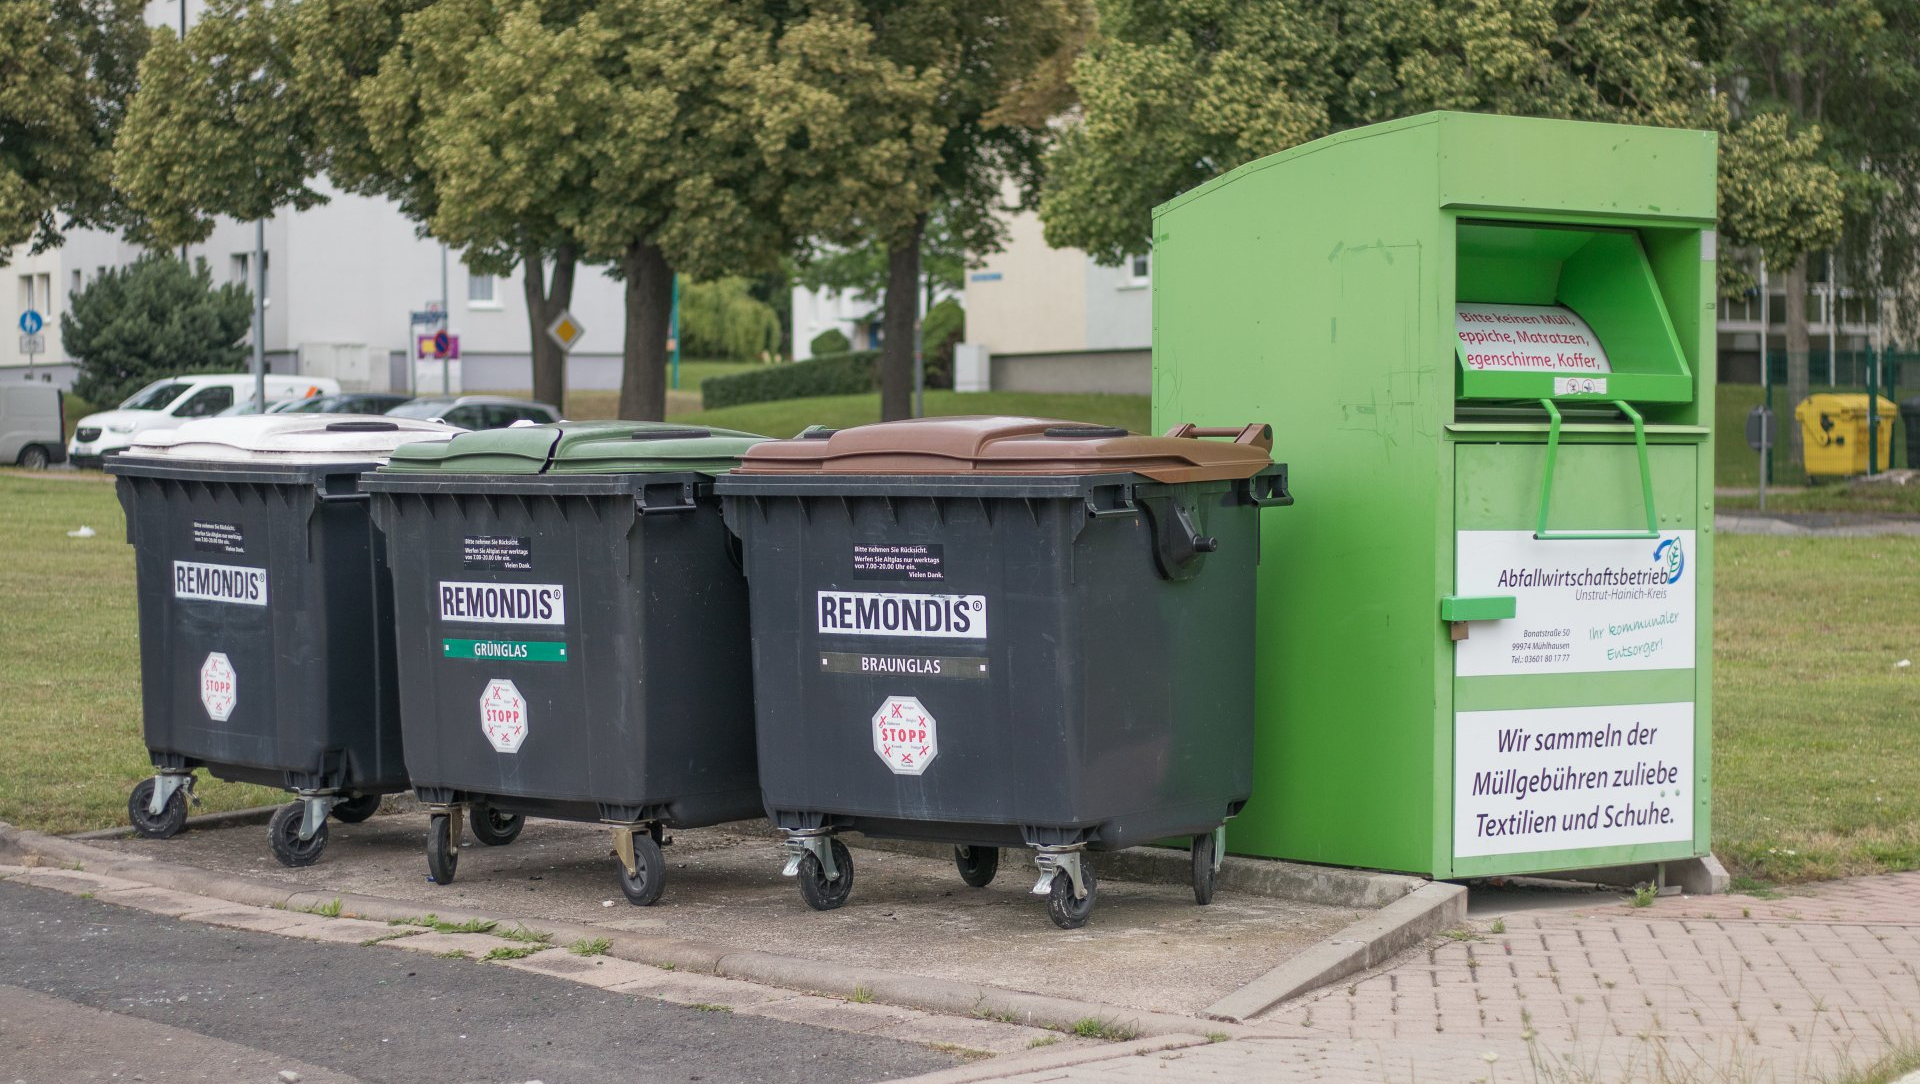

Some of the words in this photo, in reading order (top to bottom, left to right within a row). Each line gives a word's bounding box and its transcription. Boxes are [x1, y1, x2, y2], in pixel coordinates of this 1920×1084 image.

[1459, 312, 1494, 323] Bitte
[1494, 314, 1539, 324] keinen
[1540, 315, 1576, 326] Müll,
[1459, 330, 1516, 344] eppiche,
[1516, 330, 1590, 346] Matratzen,
[1467, 352, 1556, 369] egenschirme,
[1557, 353, 1600, 369] Koffer,
[1498, 567, 1669, 588] Abfallwirtschaftsbetrieb
[1576, 588, 1667, 601] Unstrut-Hainich-Kreis
[1524, 629, 1561, 637] Bonatstraße
[1589, 627, 1604, 640] Ihr
[1608, 611, 1680, 635] kommunaler
[474, 641, 527, 658] GRÜNGLAS
[1532, 642, 1570, 650] Mühlhausen
[1607, 638, 1663, 661] Entsorger!
[862, 657, 941, 674] BRAUNGLAS
[206, 680, 230, 694] STOPP
[487, 710, 519, 723] STOPP
[882, 728, 926, 743] STOPP
[1498, 728, 1530, 753] Wir
[1534, 723, 1622, 751] sammeln
[1628, 722, 1657, 746] der
[1472, 766, 1608, 800] Müllgebühren
[1613, 760, 1678, 788] zuliebe
[1476, 810, 1556, 837] Textilien
[1562, 805, 1599, 831] und
[1604, 801, 1674, 828] Schuhe.
